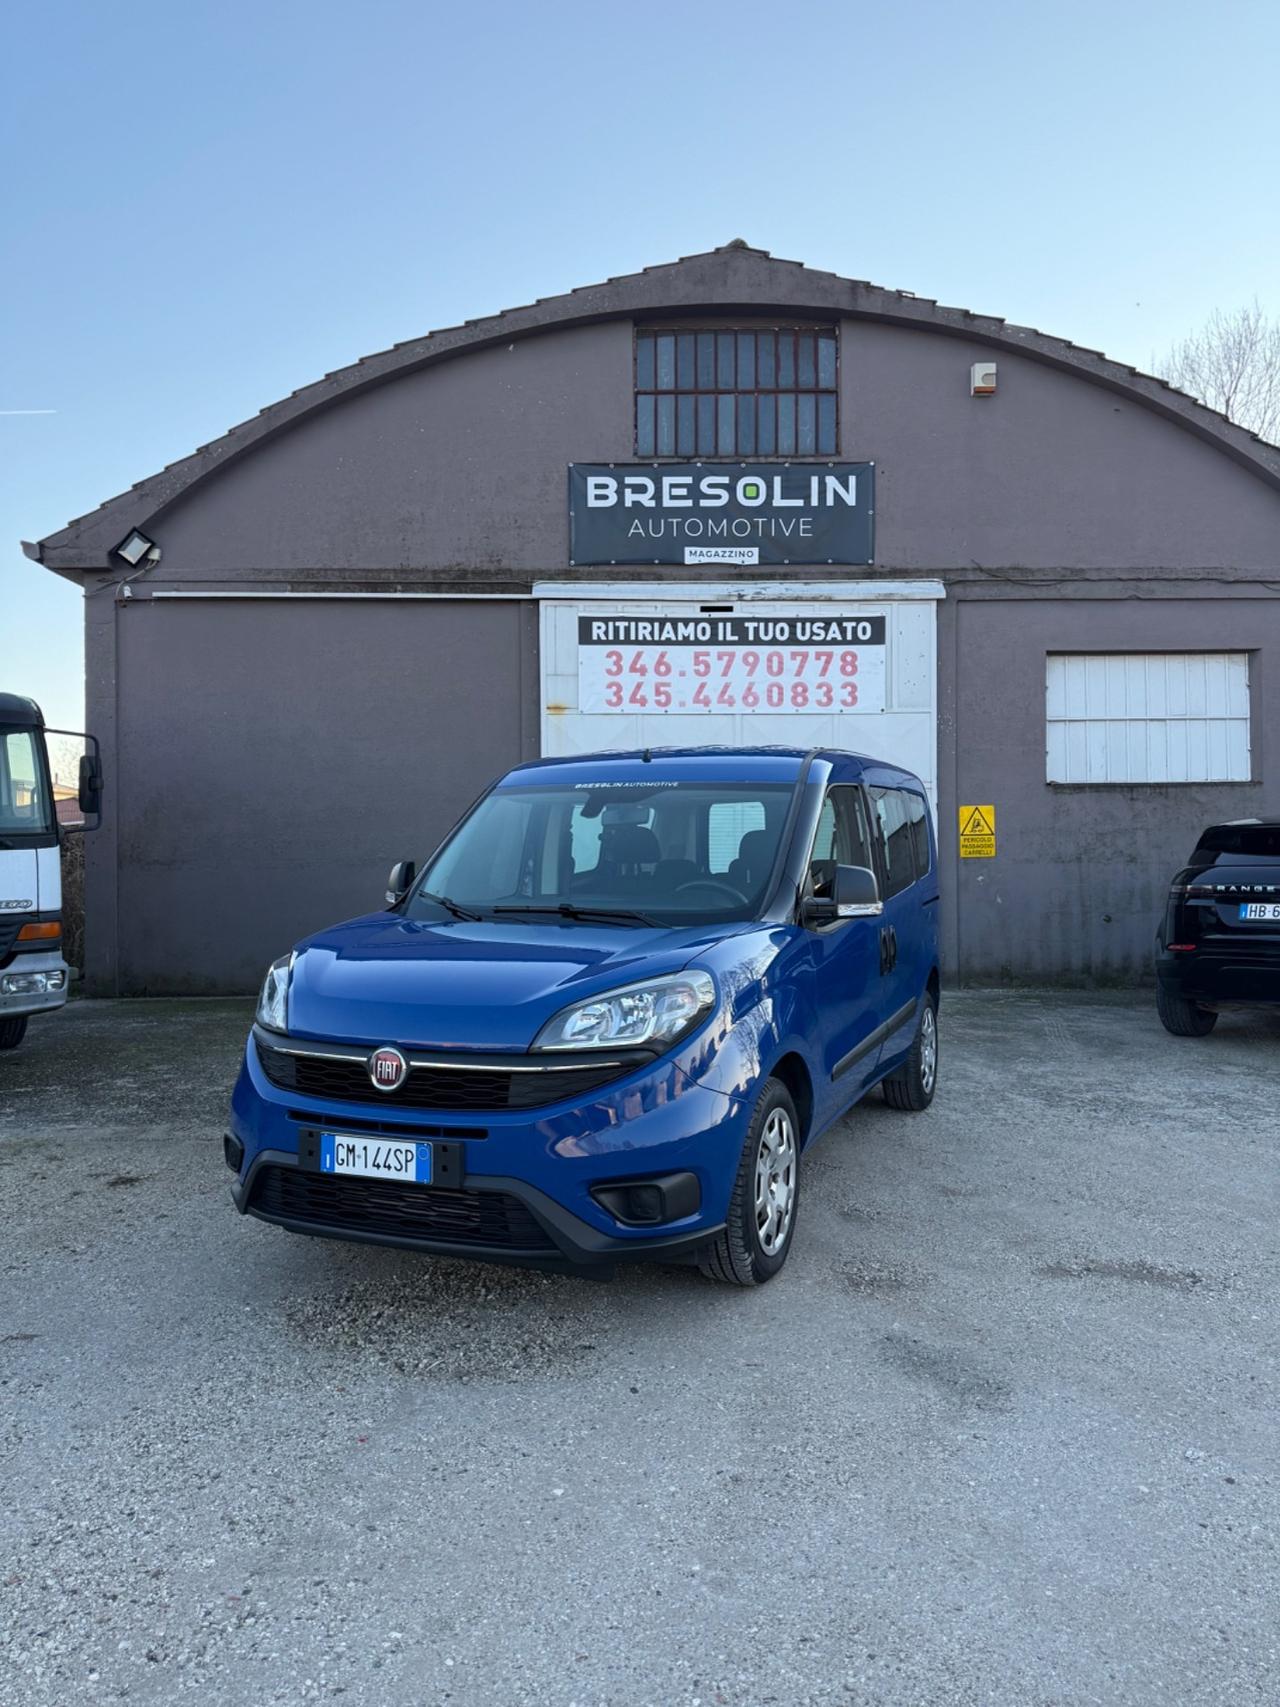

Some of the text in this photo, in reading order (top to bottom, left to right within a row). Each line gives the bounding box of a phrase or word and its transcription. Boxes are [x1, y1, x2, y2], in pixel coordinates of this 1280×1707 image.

[587, 475, 856, 508] BRESOLIN
[627, 518, 813, 537] AUTOMOTIVE
[689, 549, 754, 559] MAGAZZINO
[591, 621, 872, 641] RITIRIAMO IL TUO USATO
[605, 650, 859, 677] 346.5790778
[605, 681, 858, 708] 345.4460833
[376, 1060, 398, 1080] FIAT
